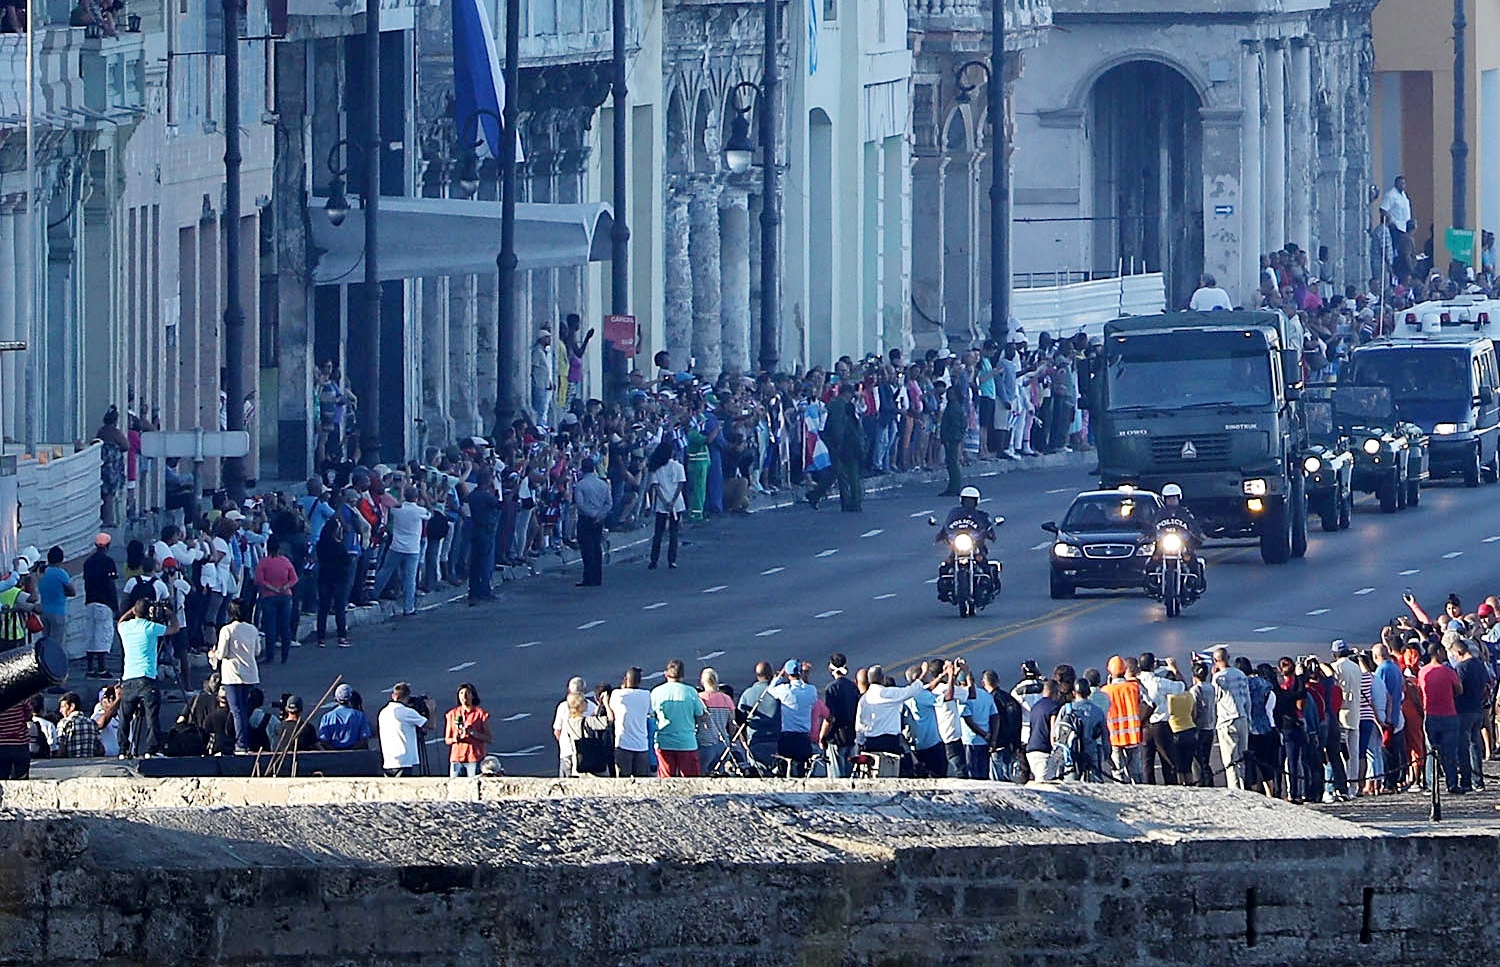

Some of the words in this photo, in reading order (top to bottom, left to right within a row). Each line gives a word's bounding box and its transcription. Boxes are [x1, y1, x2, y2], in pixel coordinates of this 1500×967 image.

[1119, 429, 1148, 437] HOWO
[948, 518, 979, 530] POLICIA
[1155, 518, 1188, 530] POLICIA
